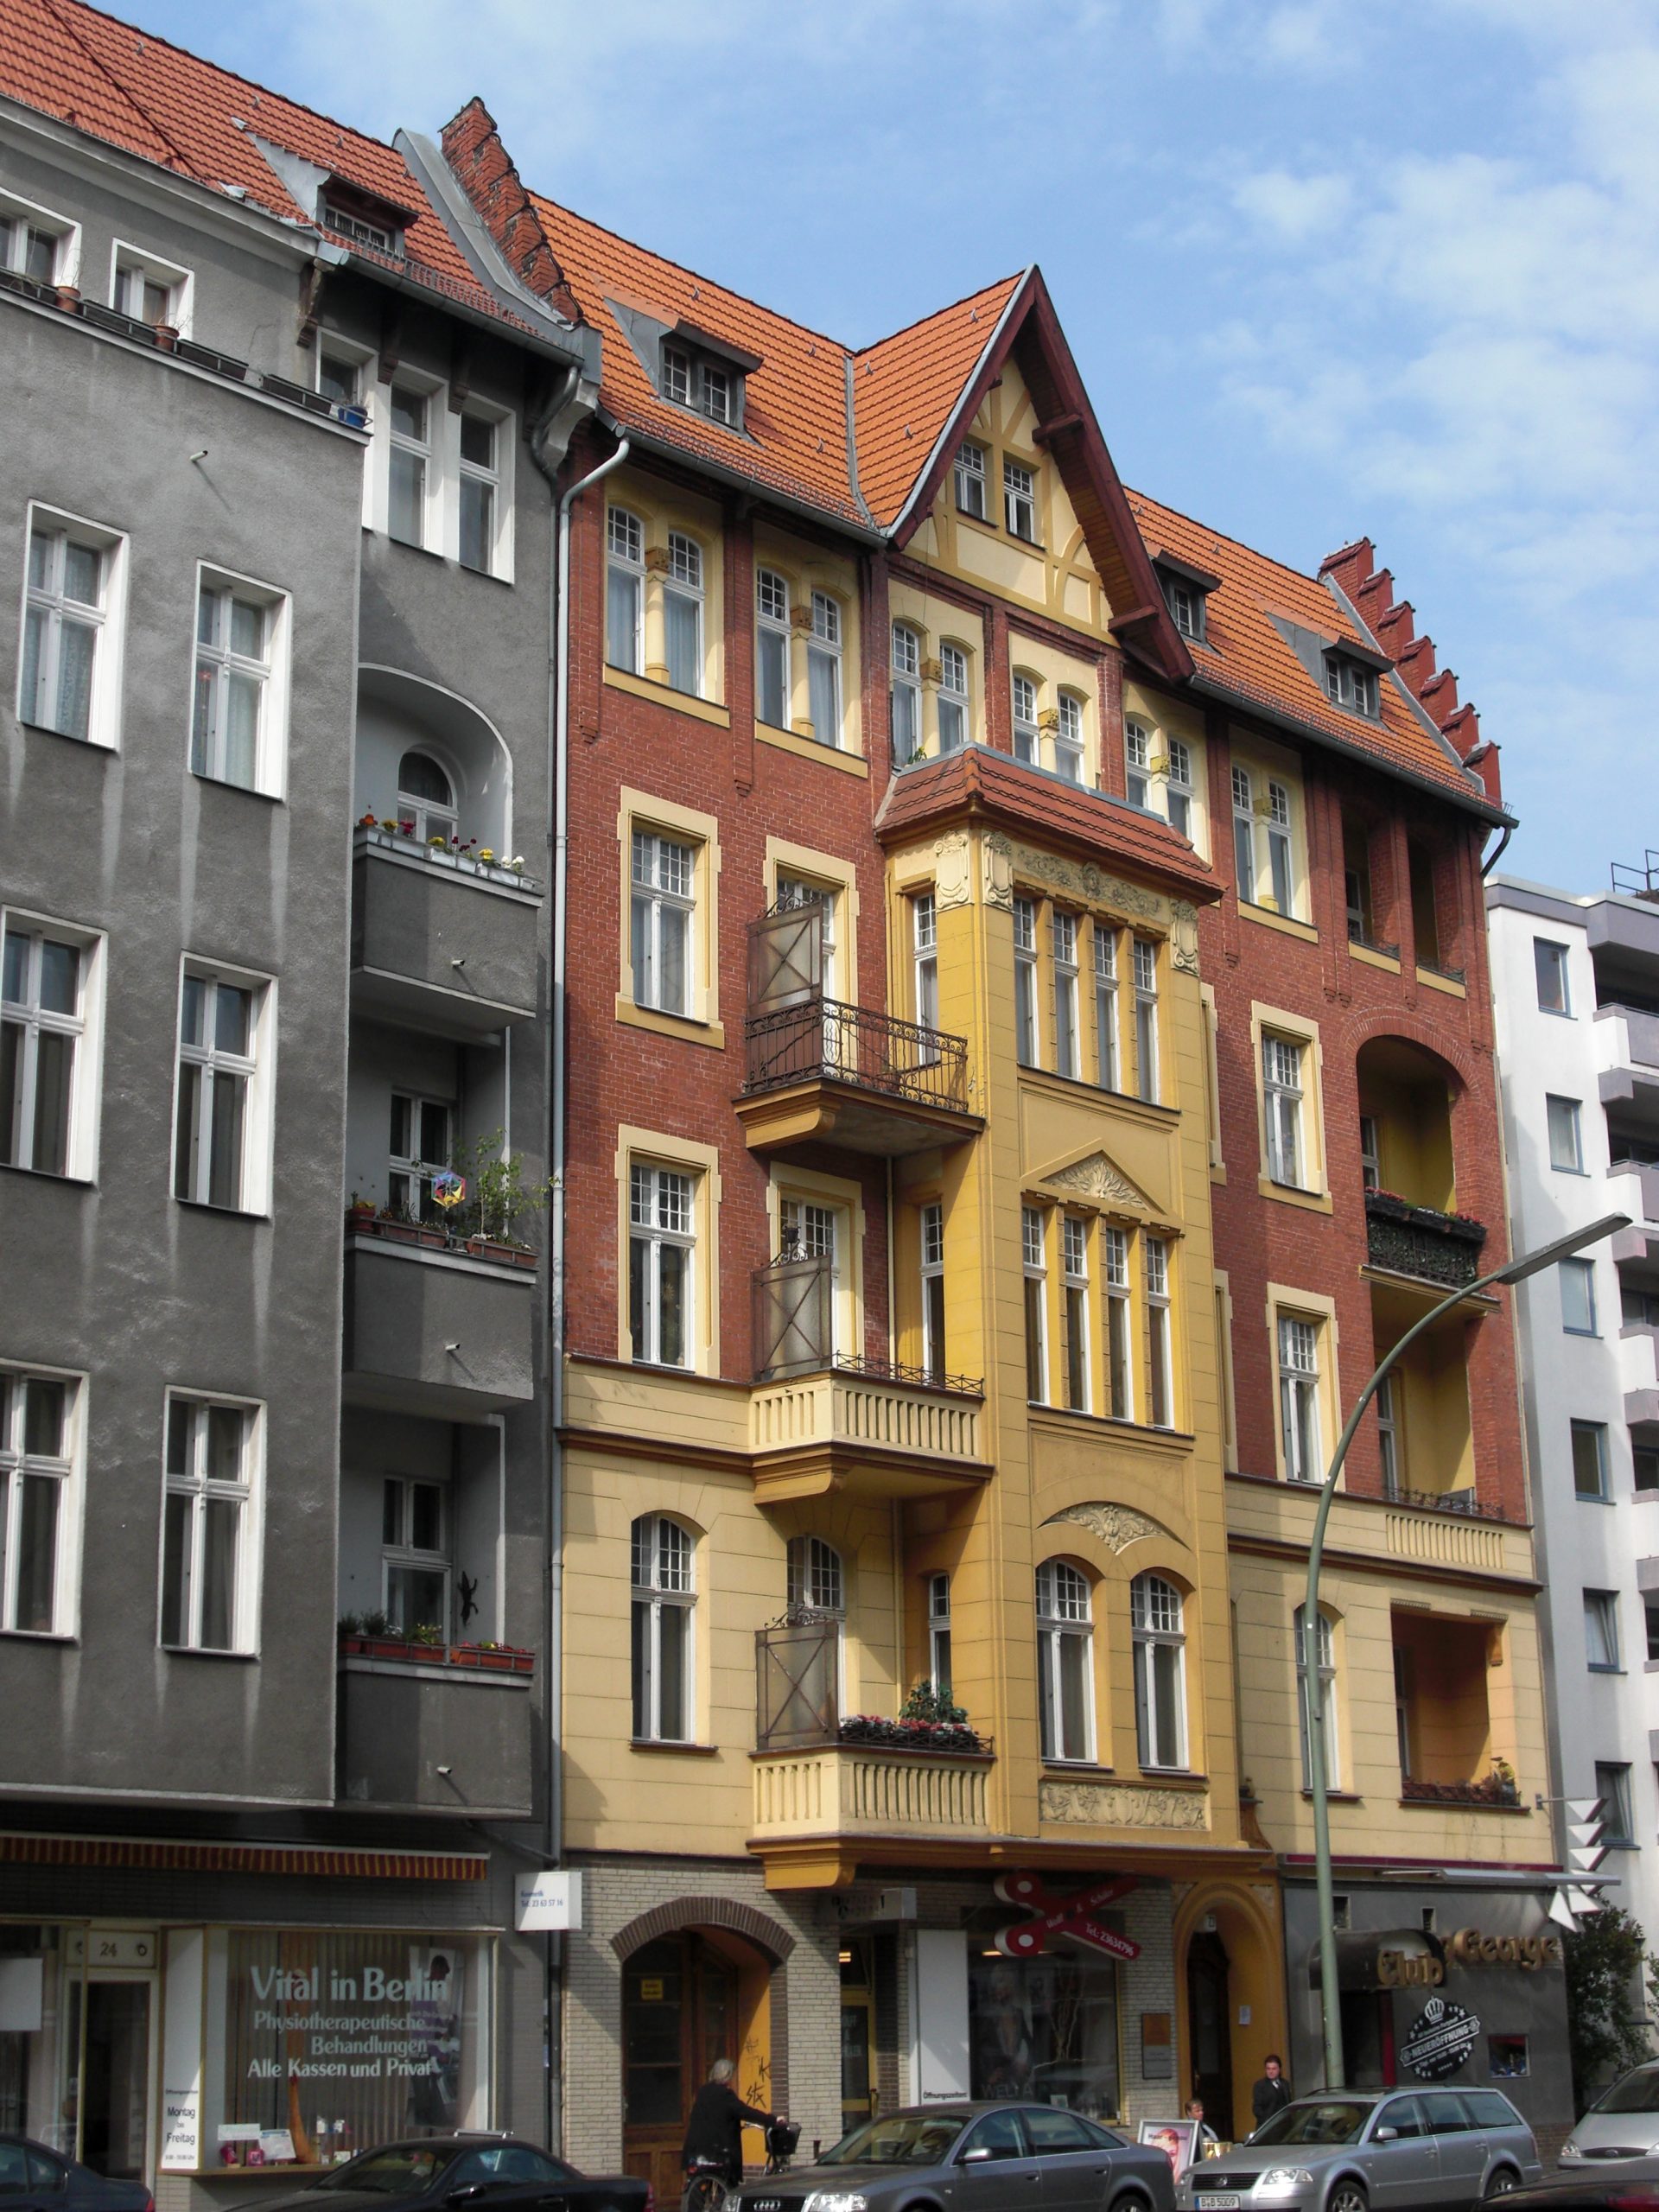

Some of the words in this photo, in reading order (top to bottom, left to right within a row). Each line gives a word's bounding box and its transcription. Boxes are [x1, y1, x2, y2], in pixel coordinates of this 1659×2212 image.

[99, 1942, 118, 1958] 24
[1453, 1928, 1559, 1971] George
[1376, 1949, 1444, 1986] Club
[250, 1966, 319, 2001] Vital
[330, 1968, 357, 2001] in
[363, 1967, 448, 2002] Berlin
[253, 2010, 426, 2035] Physiotherapeutische
[311, 2035, 428, 2058] Behandlungen
[247, 2058, 282, 2078] Alle
[288, 2058, 346, 2077] Kassen
[350, 2060, 381, 2078] und
[386, 2057, 432, 2076] Privat
[167, 2107, 196, 2119] Montag
[166, 2132, 196, 2145] Freitag
